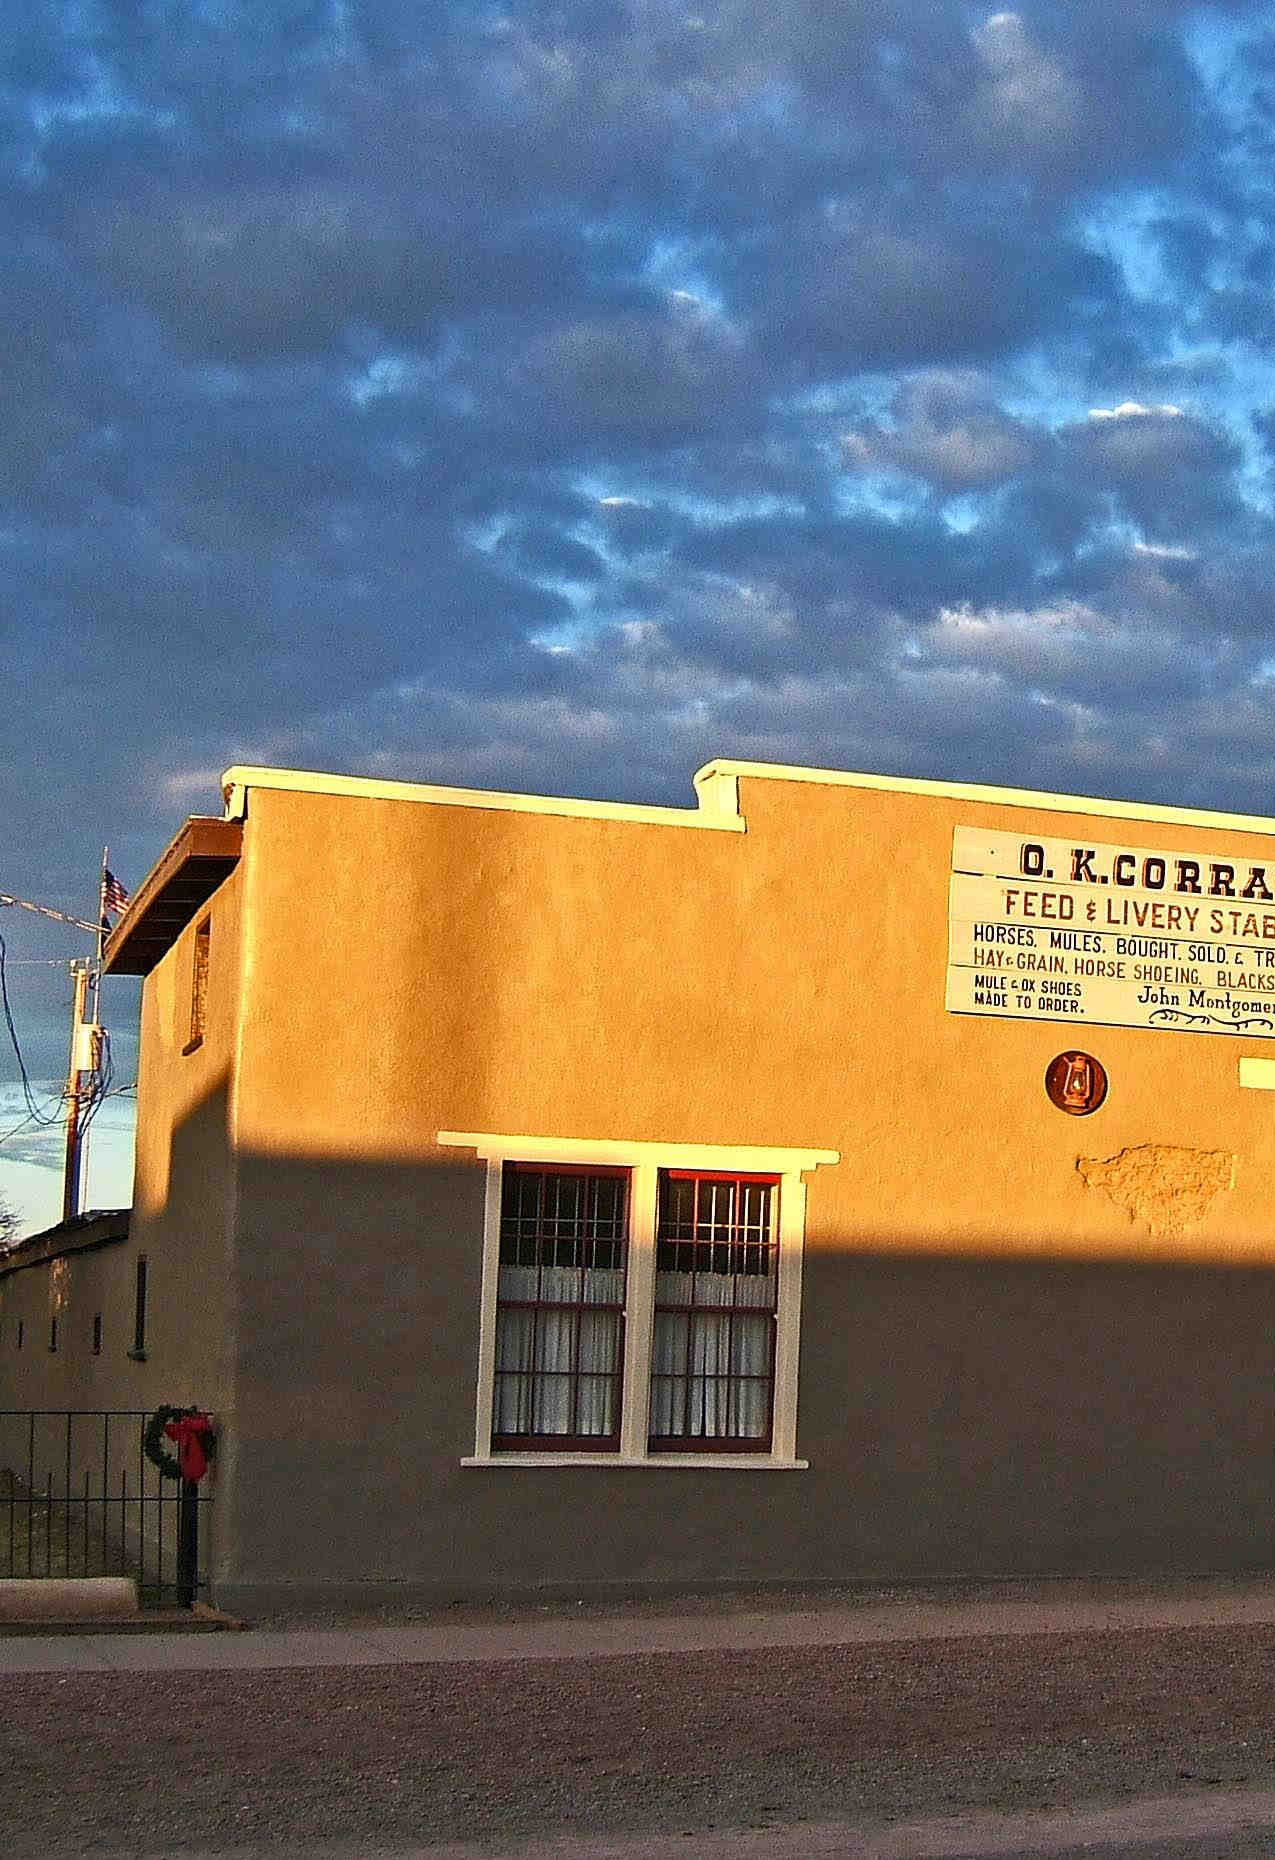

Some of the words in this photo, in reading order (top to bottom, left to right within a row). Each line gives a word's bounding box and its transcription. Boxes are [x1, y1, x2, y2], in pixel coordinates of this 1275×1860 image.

[1006, 889, 1074, 920] FEED
[1086, 899, 1097, 923] &
[1107, 898, 1200, 932] LIVERY
[974, 947, 1005, 967] HAY
[1074, 957, 1126, 979] HORSE
[974, 974, 1007, 990] MULE
[1021, 978, 1036, 992] OX
[1041, 980, 1082, 997] SHOES
[1138, 986, 1180, 1006] John
[974, 991, 1008, 1007] MADE
[1016, 995, 1032, 1009] TO
[1038, 997, 1085, 1013] ORDER.
